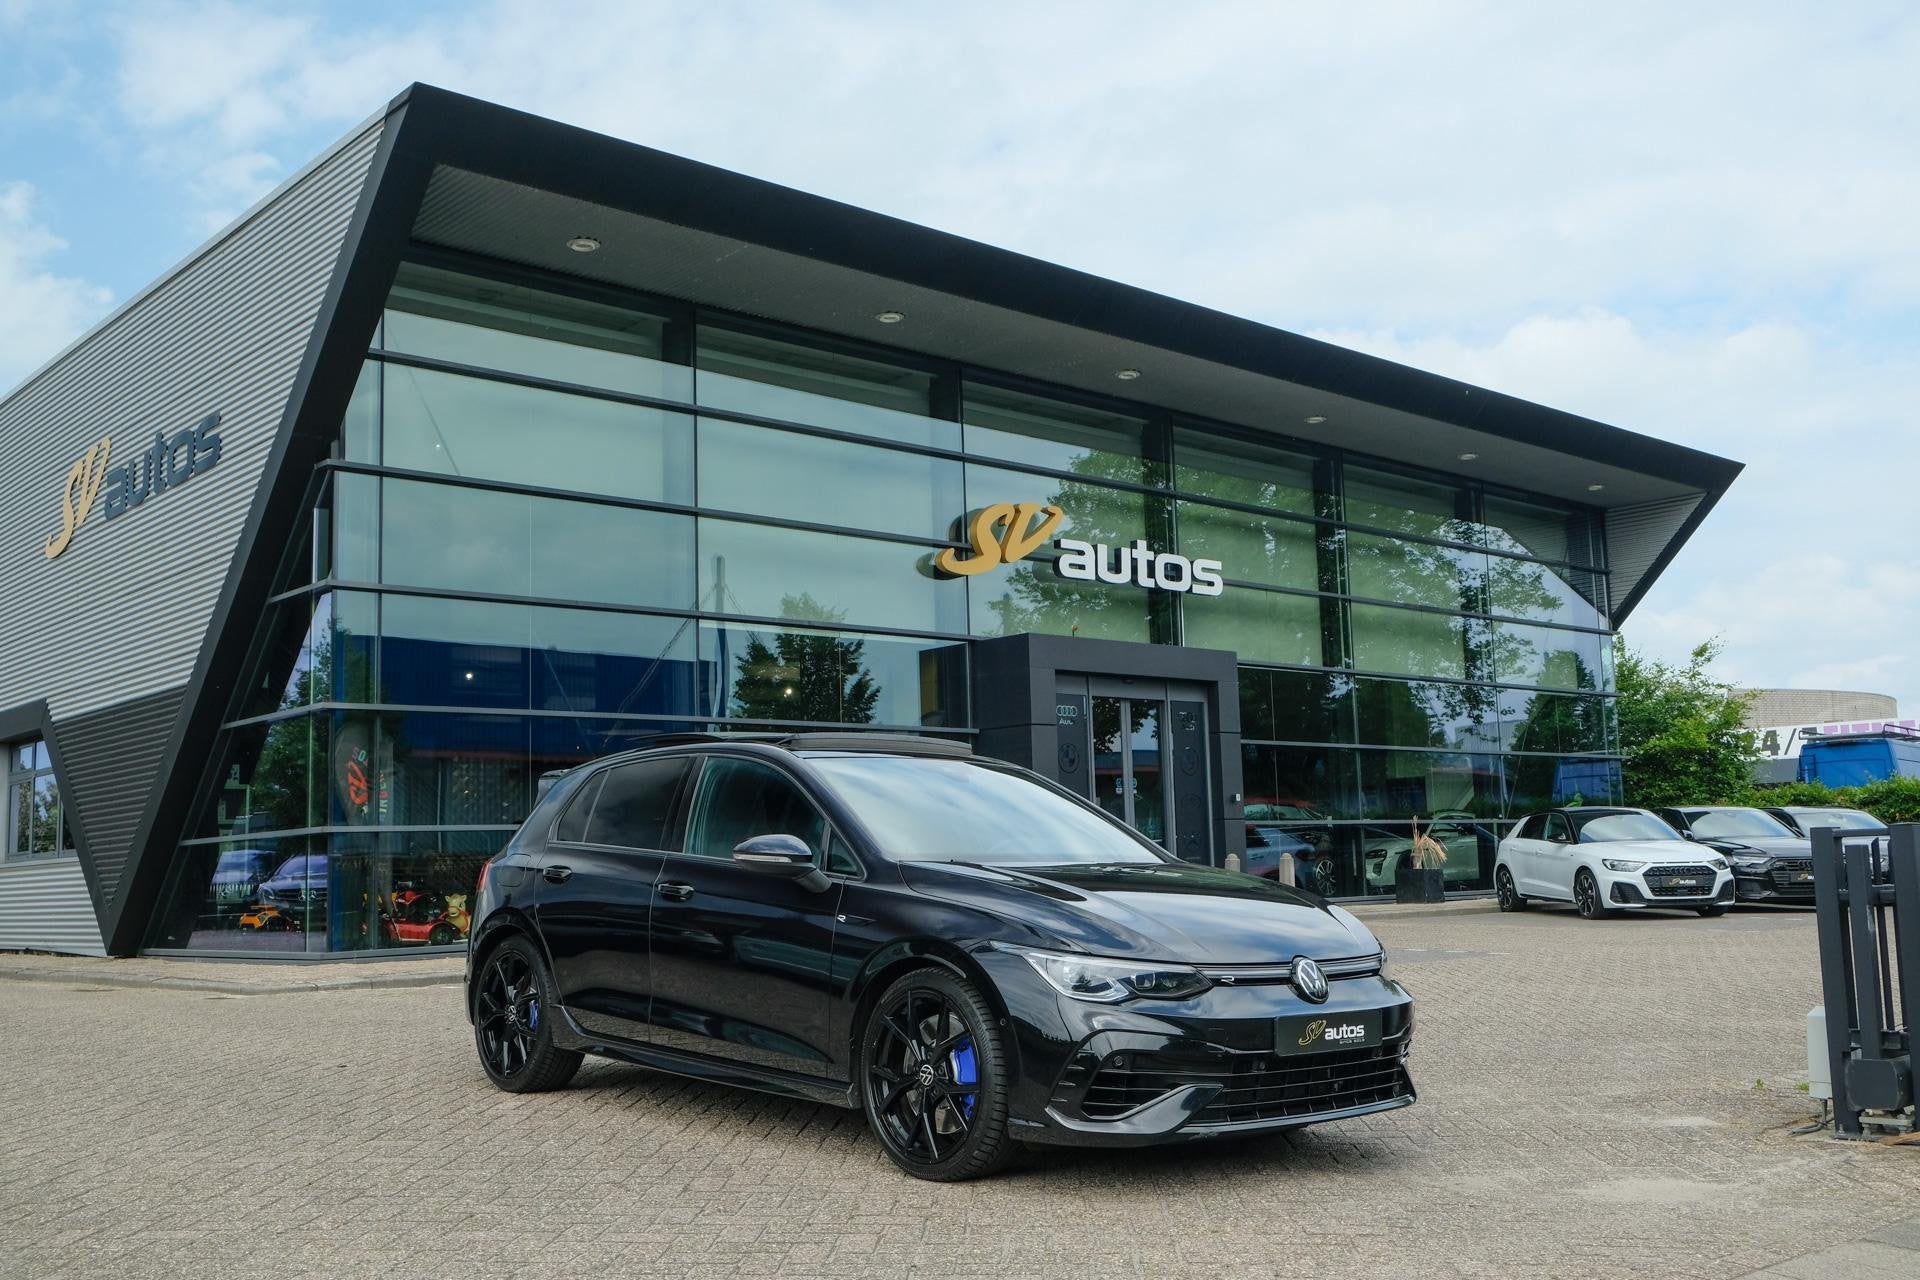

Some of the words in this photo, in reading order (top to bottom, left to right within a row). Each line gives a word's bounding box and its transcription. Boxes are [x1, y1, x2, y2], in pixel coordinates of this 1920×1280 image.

[45, 437, 112, 559] SV
[104, 411, 222, 520] autos
[936, 503, 1064, 576] SV
[1054, 538, 1224, 596] autos
[1298, 1020, 1327, 1045] SV
[1324, 1023, 1365, 1041] autos
